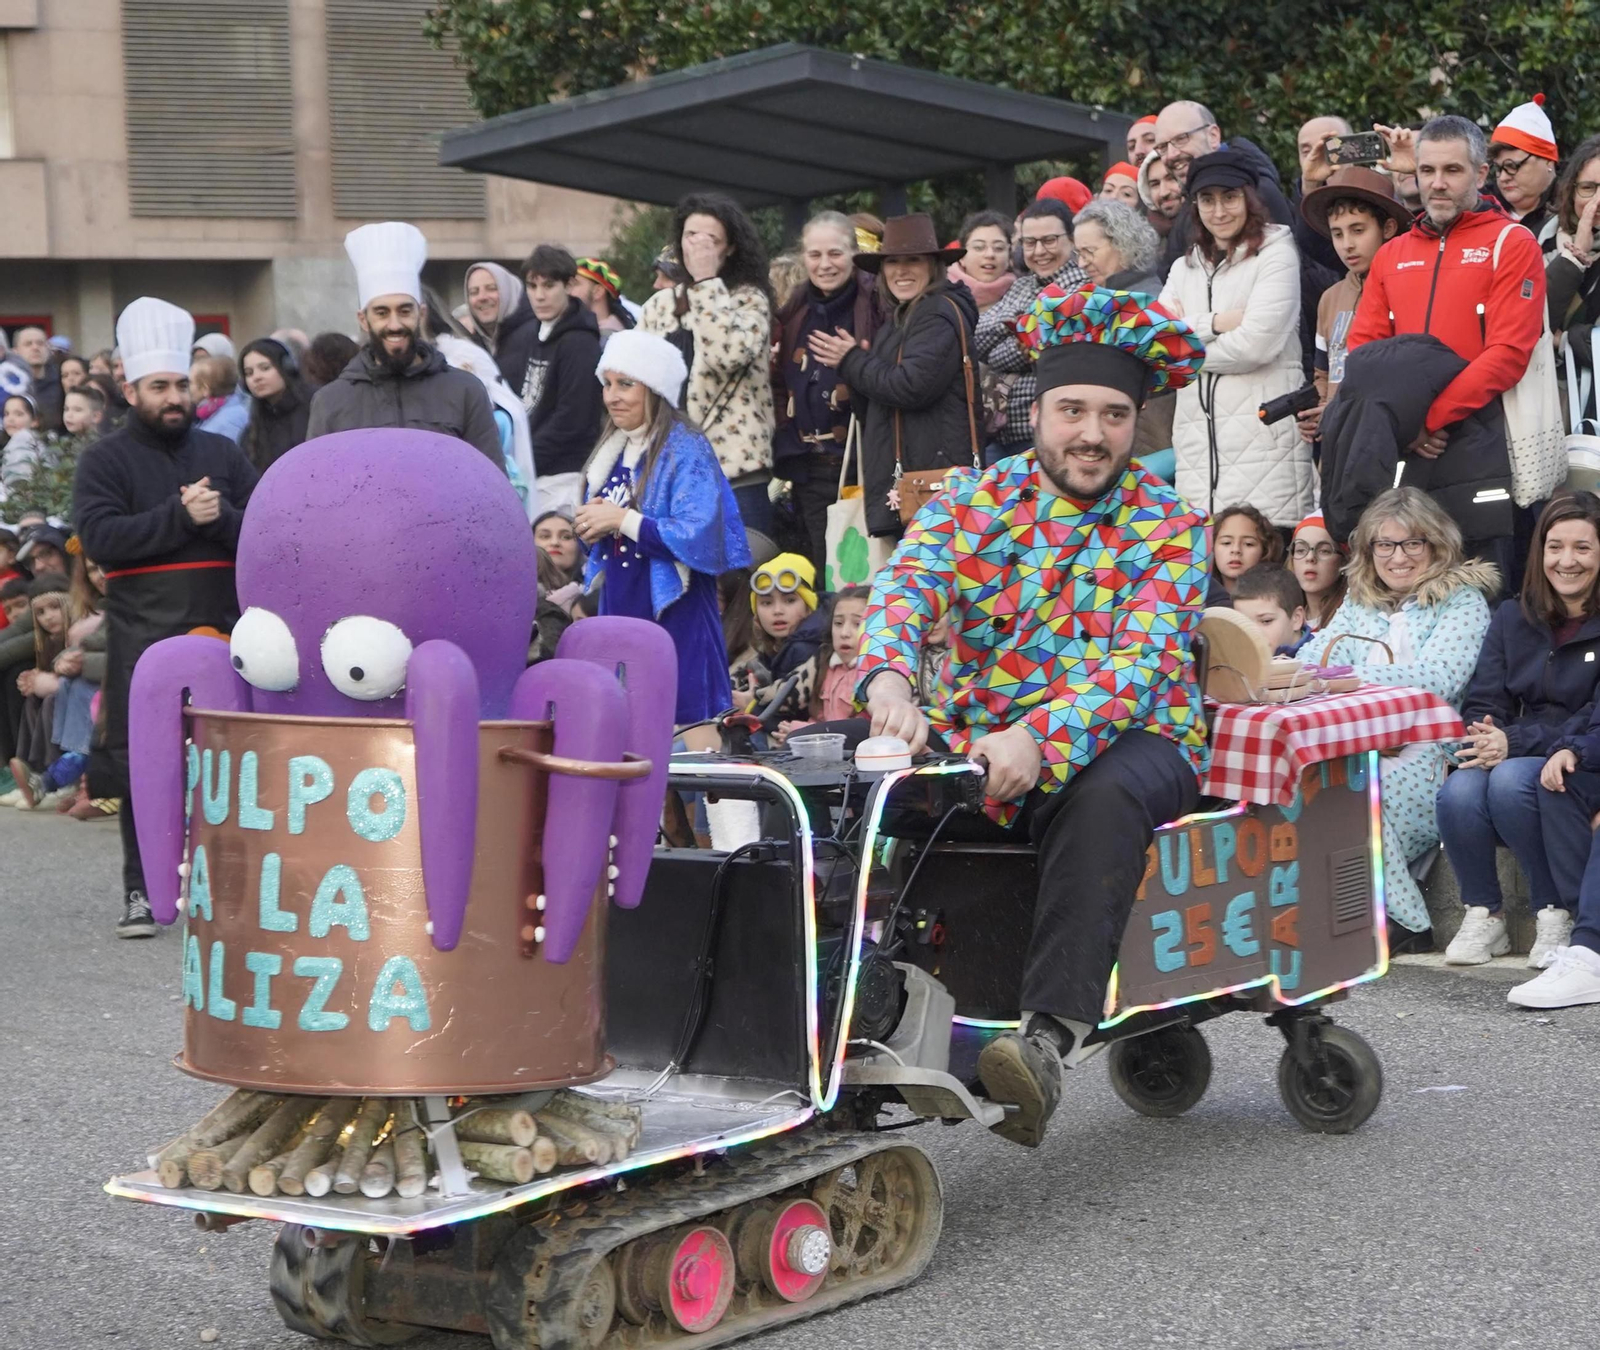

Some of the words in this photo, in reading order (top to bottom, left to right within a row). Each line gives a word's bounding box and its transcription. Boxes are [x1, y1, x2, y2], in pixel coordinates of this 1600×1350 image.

[188, 844, 213, 922] A
[258, 851, 371, 943] LA
[182, 923, 432, 1032] ALIZA
